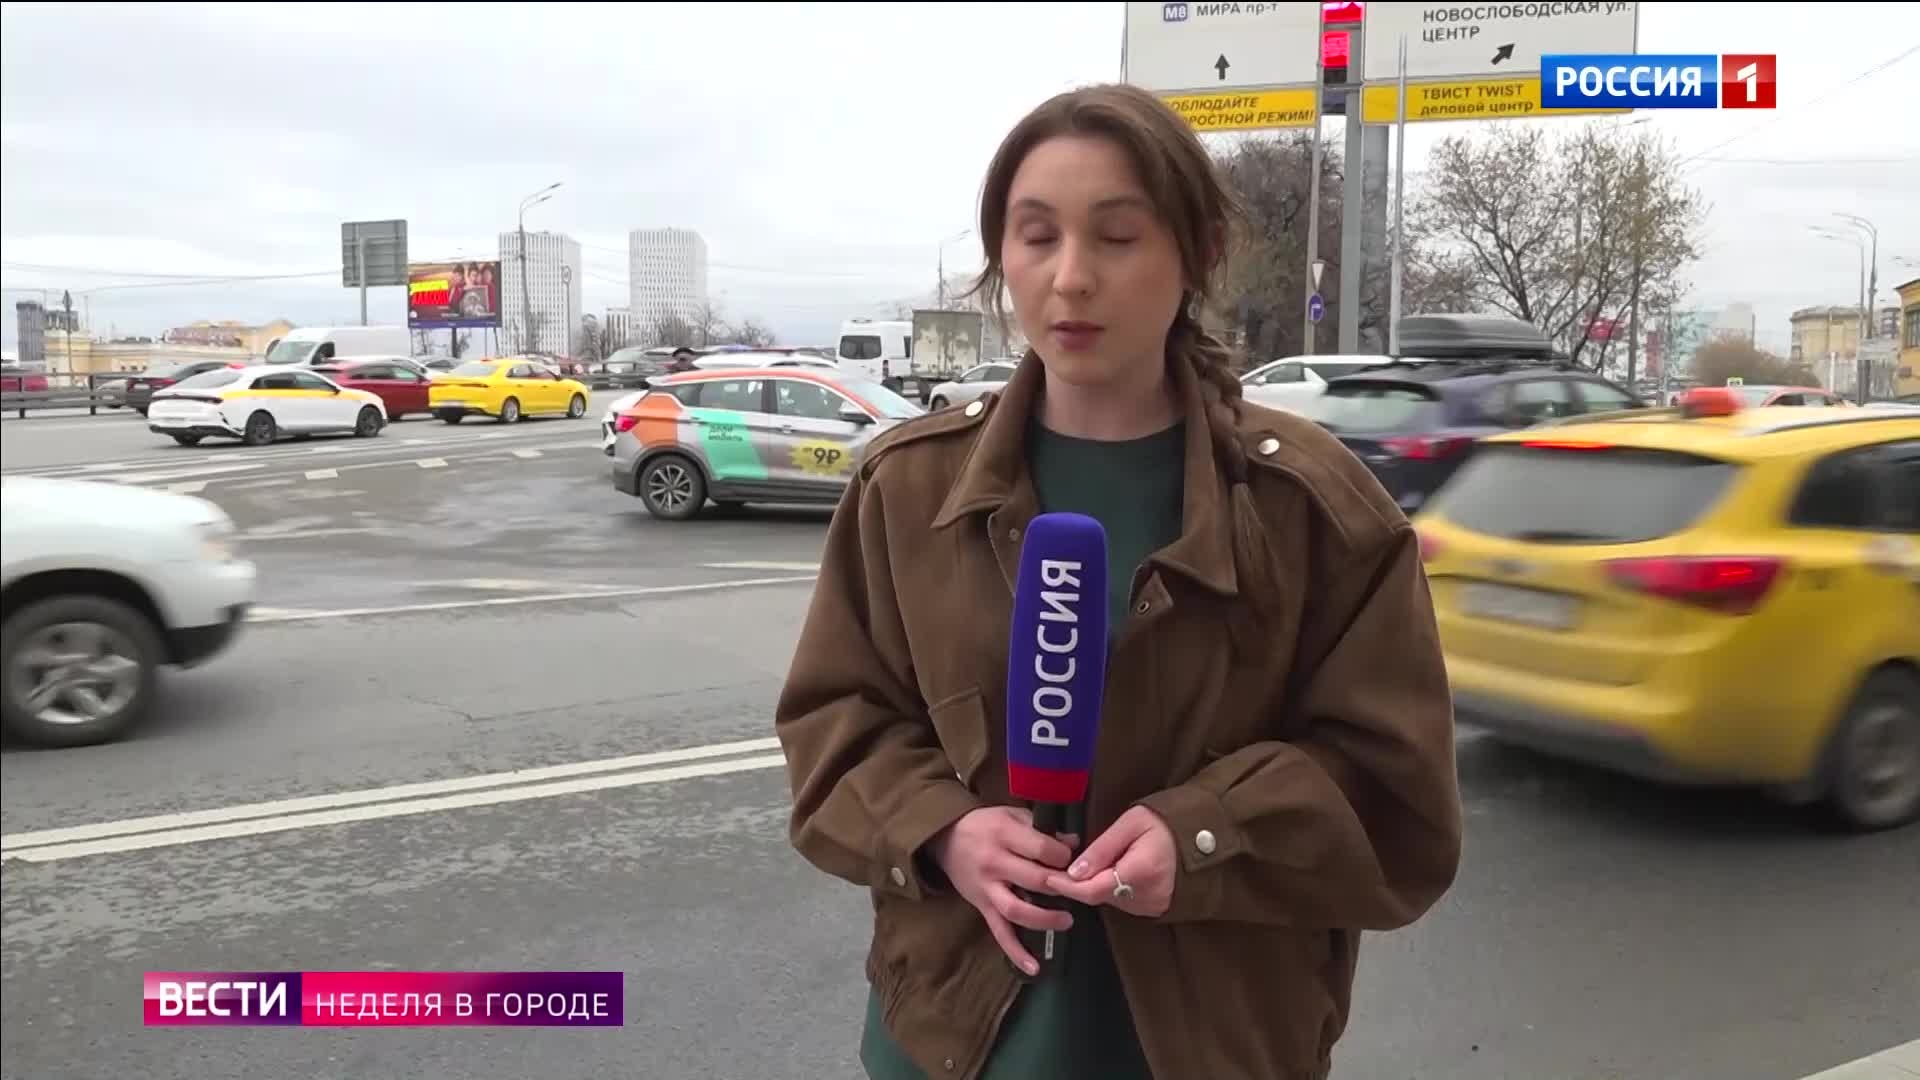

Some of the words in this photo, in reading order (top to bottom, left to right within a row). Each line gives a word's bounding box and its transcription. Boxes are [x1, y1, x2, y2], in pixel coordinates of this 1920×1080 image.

[1196, 3, 1241, 17] МИРА
[1246, 3, 1278, 16] пр-т
[1423, 2, 1600, 22] НОВОСЛОБОДСКАЯ
[1606, 2, 1631, 15] ул.
[1423, 26, 1480, 42] ЦЕНТР
[1422, 87, 1472, 101] ТВИСТ
[1476, 83, 1524, 98] TWIST
[1420, 102, 1485, 116] деловой
[1489, 100, 1534, 114] центр
[1184, 111, 1255, 126] РОСТНОЙ
[1257, 110, 1314, 124] РЕЖИМ!
[1031, 559, 1082, 748] РОССИЯ
